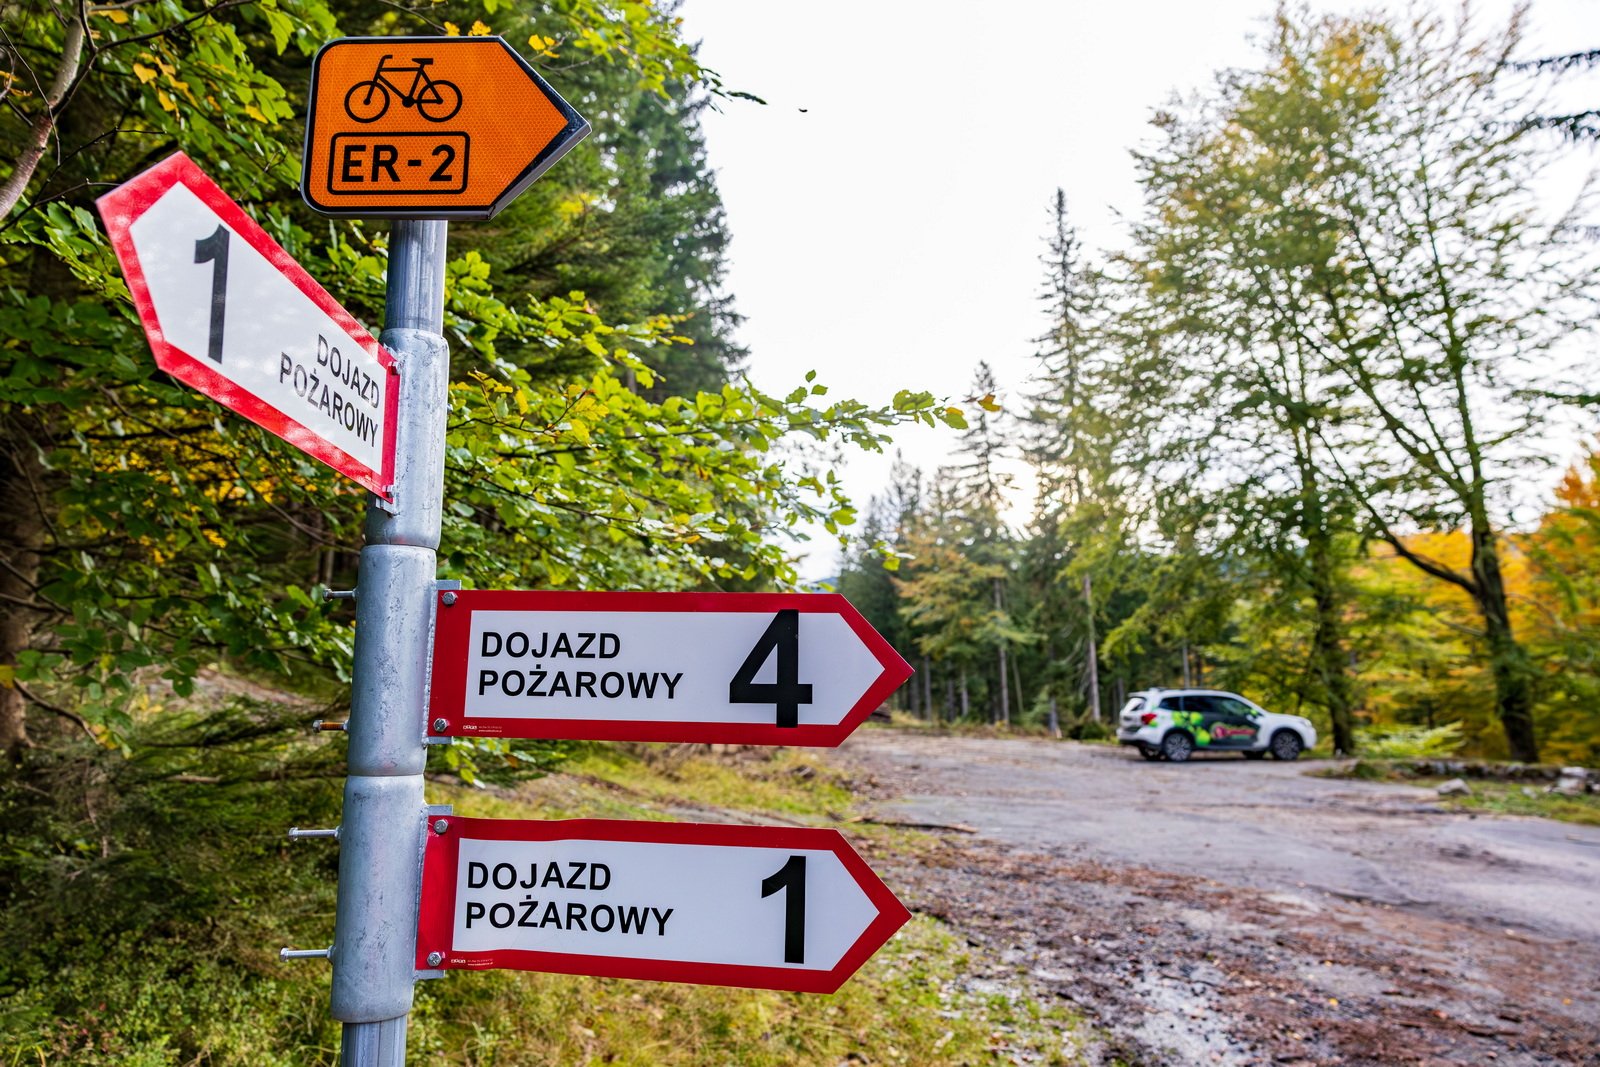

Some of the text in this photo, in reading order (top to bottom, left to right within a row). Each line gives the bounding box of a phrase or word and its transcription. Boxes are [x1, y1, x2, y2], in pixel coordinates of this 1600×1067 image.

[341, 144, 456, 183] ER-2
[194, 224, 231, 365] 1
[279, 351, 379, 448] POŻAROWY
[317, 333, 380, 409] DOJAZD
[480, 631, 621, 659] DOJAZD
[729, 609, 813, 728] 4
[478, 664, 684, 700] POŻAROWY
[467, 861, 611, 891] DOJAZD
[465, 894, 674, 937] POŻAROWY
[761, 855, 807, 964] 1
